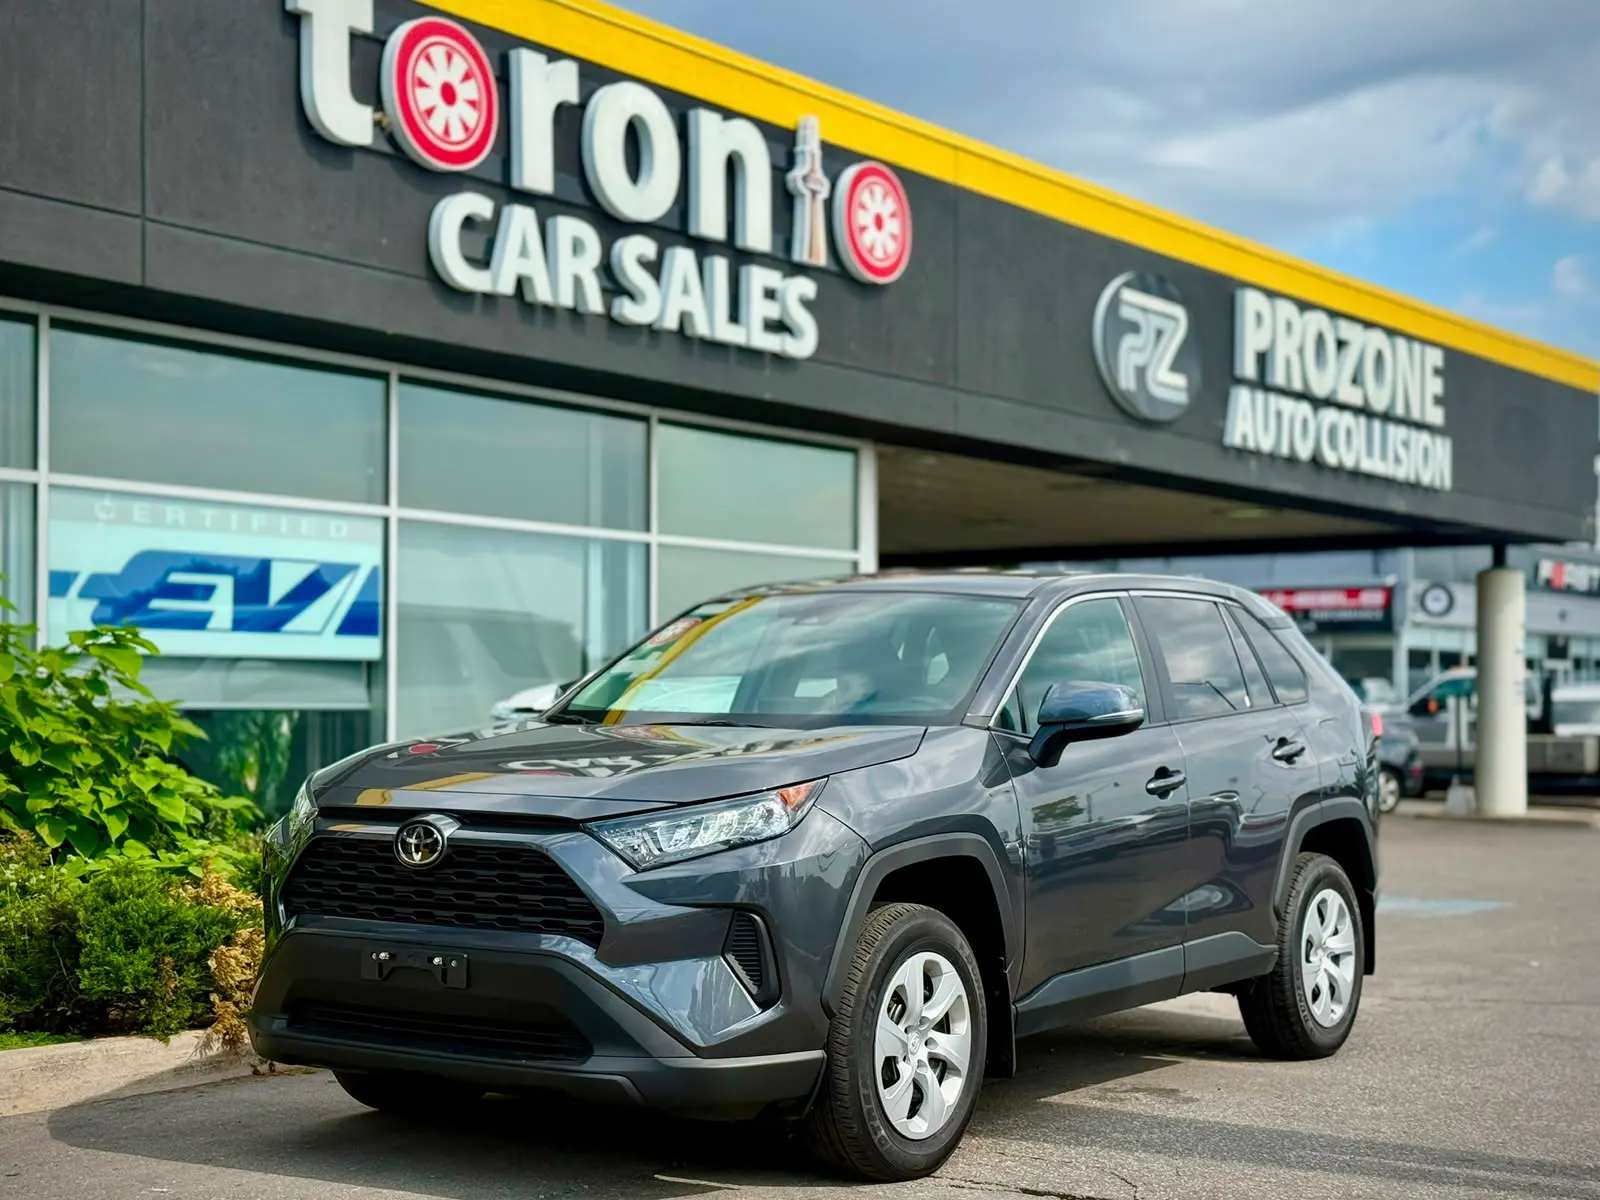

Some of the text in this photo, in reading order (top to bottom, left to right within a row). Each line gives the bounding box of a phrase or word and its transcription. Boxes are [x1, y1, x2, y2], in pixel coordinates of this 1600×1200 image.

[428, 191, 819, 360] CAR SALES
[1234, 287, 1446, 428] PROZONE
[1223, 384, 1454, 492] AUTO COLLISION
[93, 498, 351, 538] CERTIFIED
